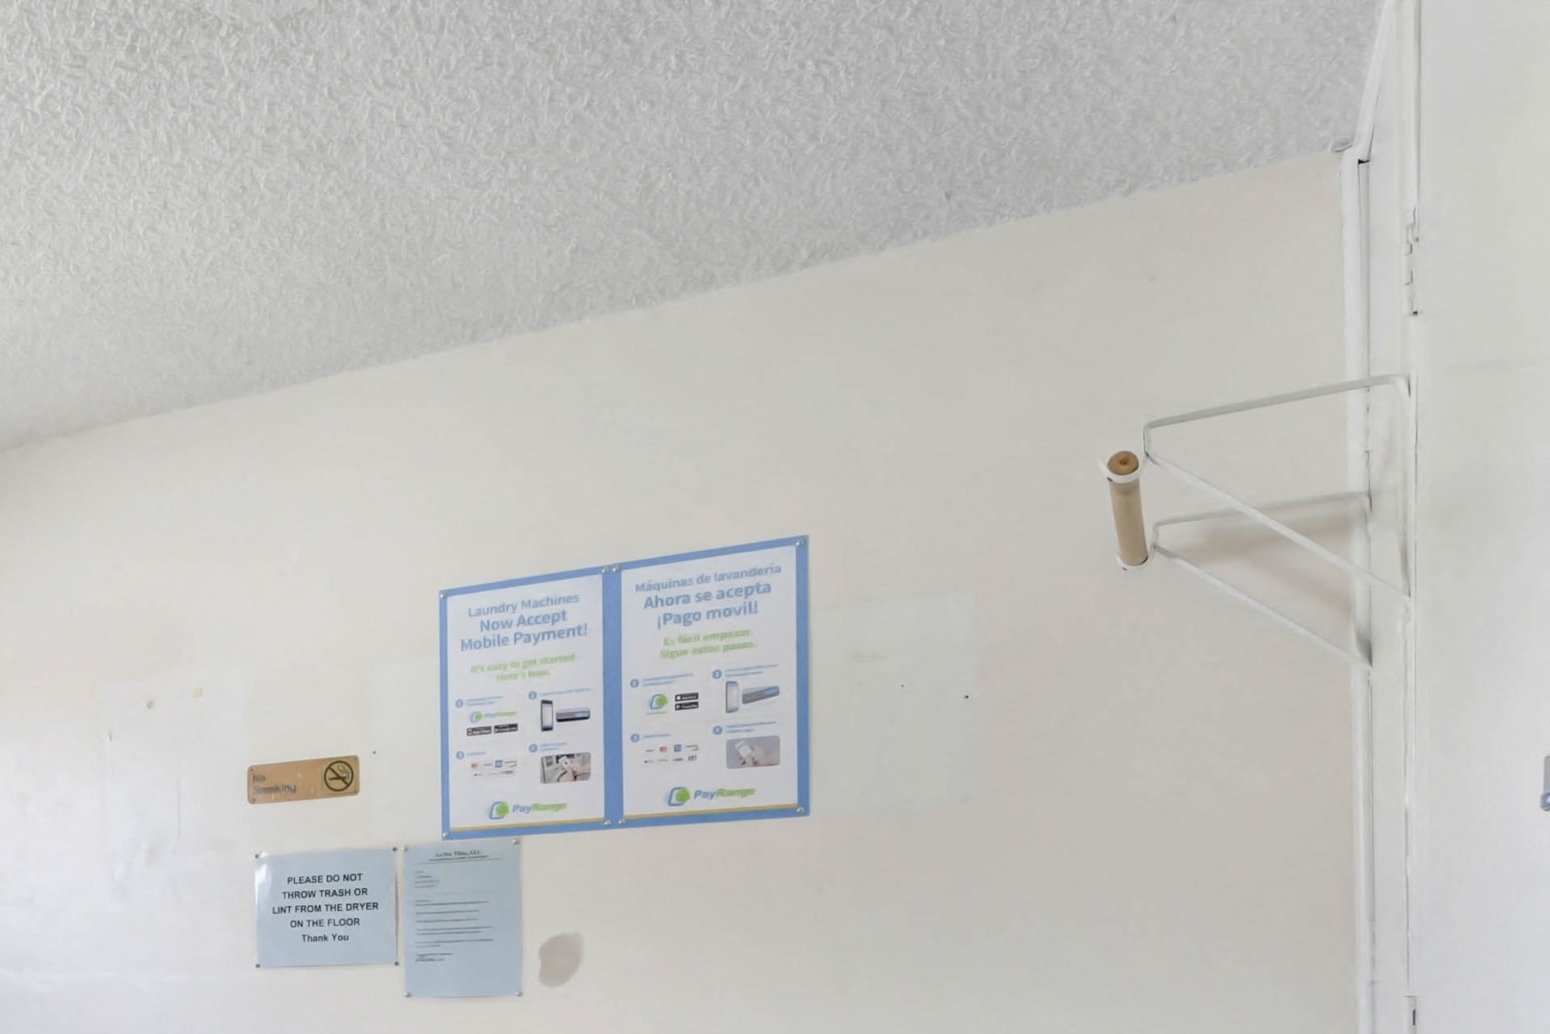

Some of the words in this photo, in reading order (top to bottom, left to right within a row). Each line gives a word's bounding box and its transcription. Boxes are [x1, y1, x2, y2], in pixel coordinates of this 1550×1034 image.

[635, 577, 693, 592] Máquinas
[696, 573, 711, 585] de
[714, 562, 782, 581] lavandería
[644, 593, 691, 609] Ahora
[695, 589, 712, 602] se
[716, 582, 772, 600] acepta
[468, 602, 518, 617] Laundry
[521, 594, 580, 609] Machines
[480, 619, 513, 632] Now
[516, 609, 568, 627] Accept
[657, 610, 702, 629] ¡Pago
[706, 600, 758, 620] movil!
[460, 634, 510, 651] Mobile
[513, 623, 588, 645] Payment!
[694, 788, 756, 801] PayRange
[512, 803, 567, 814] PayRange
[287, 875, 323, 885] PLEASE
[326, 874, 340, 883] DO
[343, 873, 363, 882] NOT
[282, 890, 316, 899] THROW
[319, 889, 351, 897] TRASH
[354, 887, 368, 896] OR
[272, 906, 292, 914] LINT
[295, 904, 321, 913] FROM
[325, 903, 342, 912] THE
[346, 902, 379, 911] DRYER
[290, 920, 303, 928] ON
[307, 919, 324, 927] THE
[327, 917, 360, 927] FLOOR
[302, 934, 328, 942] Thank
[332, 933, 349, 941] You
